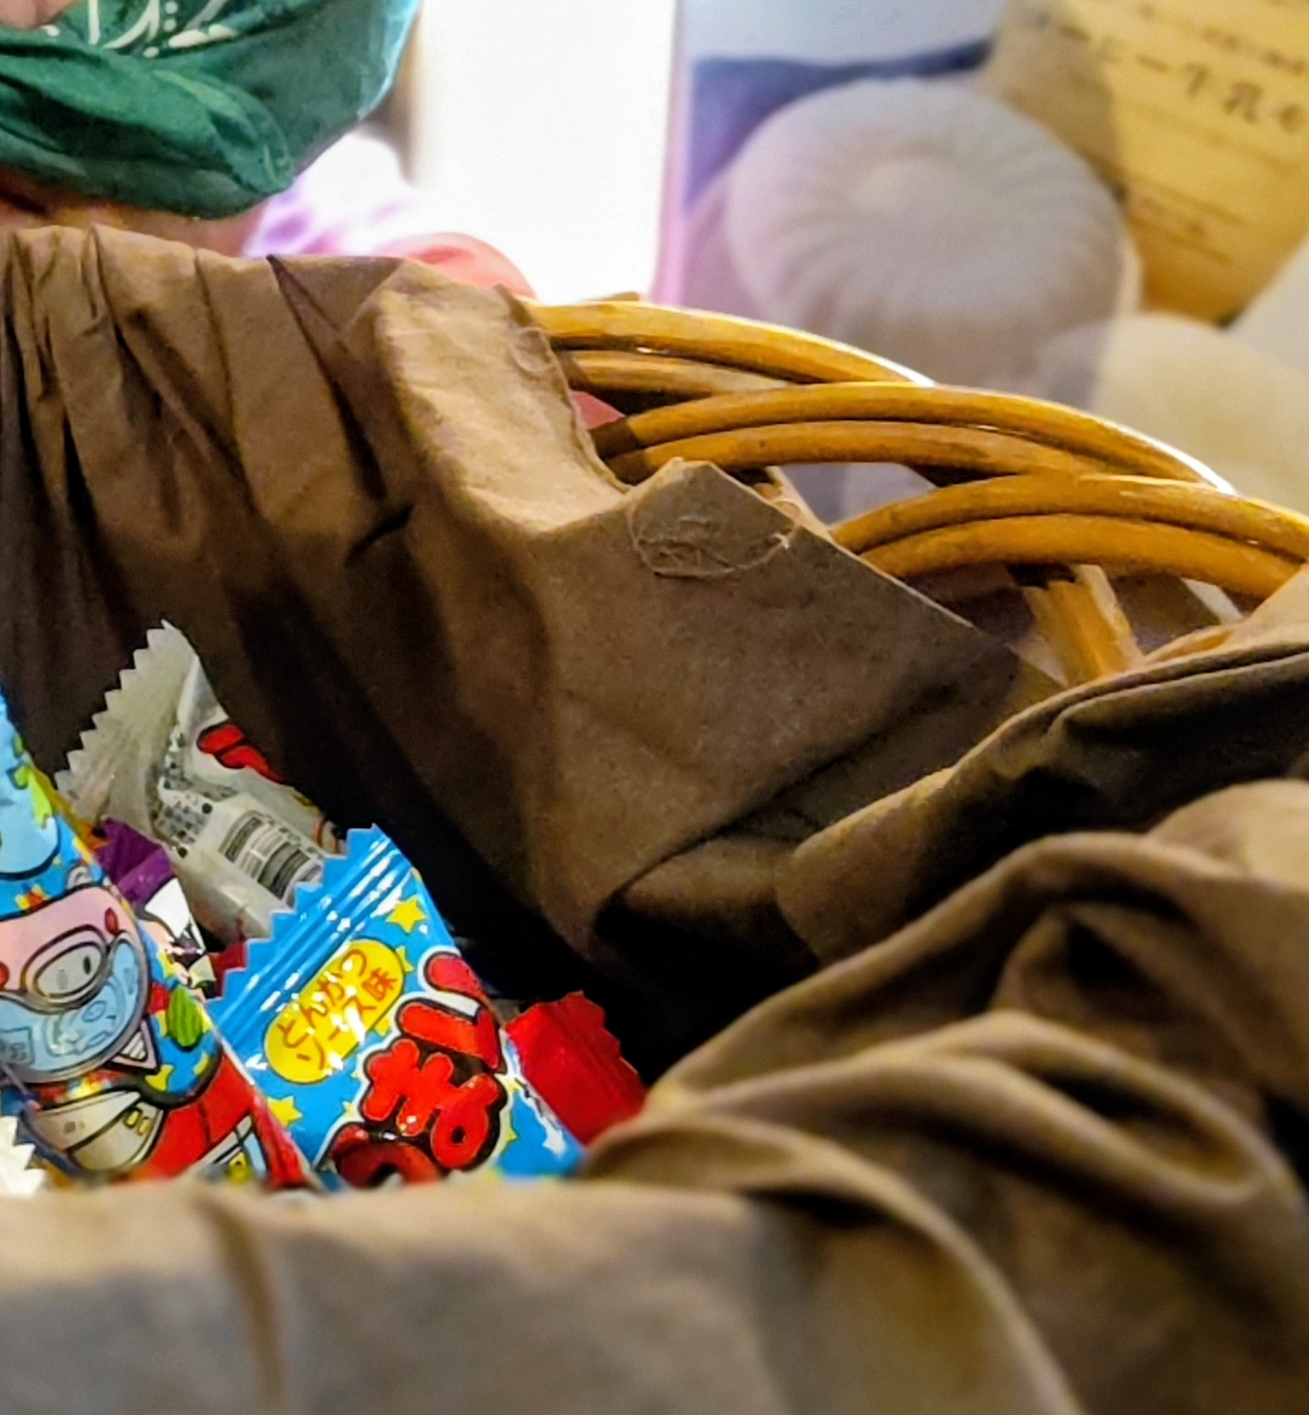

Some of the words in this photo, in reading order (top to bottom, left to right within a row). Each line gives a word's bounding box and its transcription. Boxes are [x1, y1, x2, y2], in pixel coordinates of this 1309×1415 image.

[277, 946, 370, 1049] とんかつ
[293, 966, 397, 1073] ソース味
